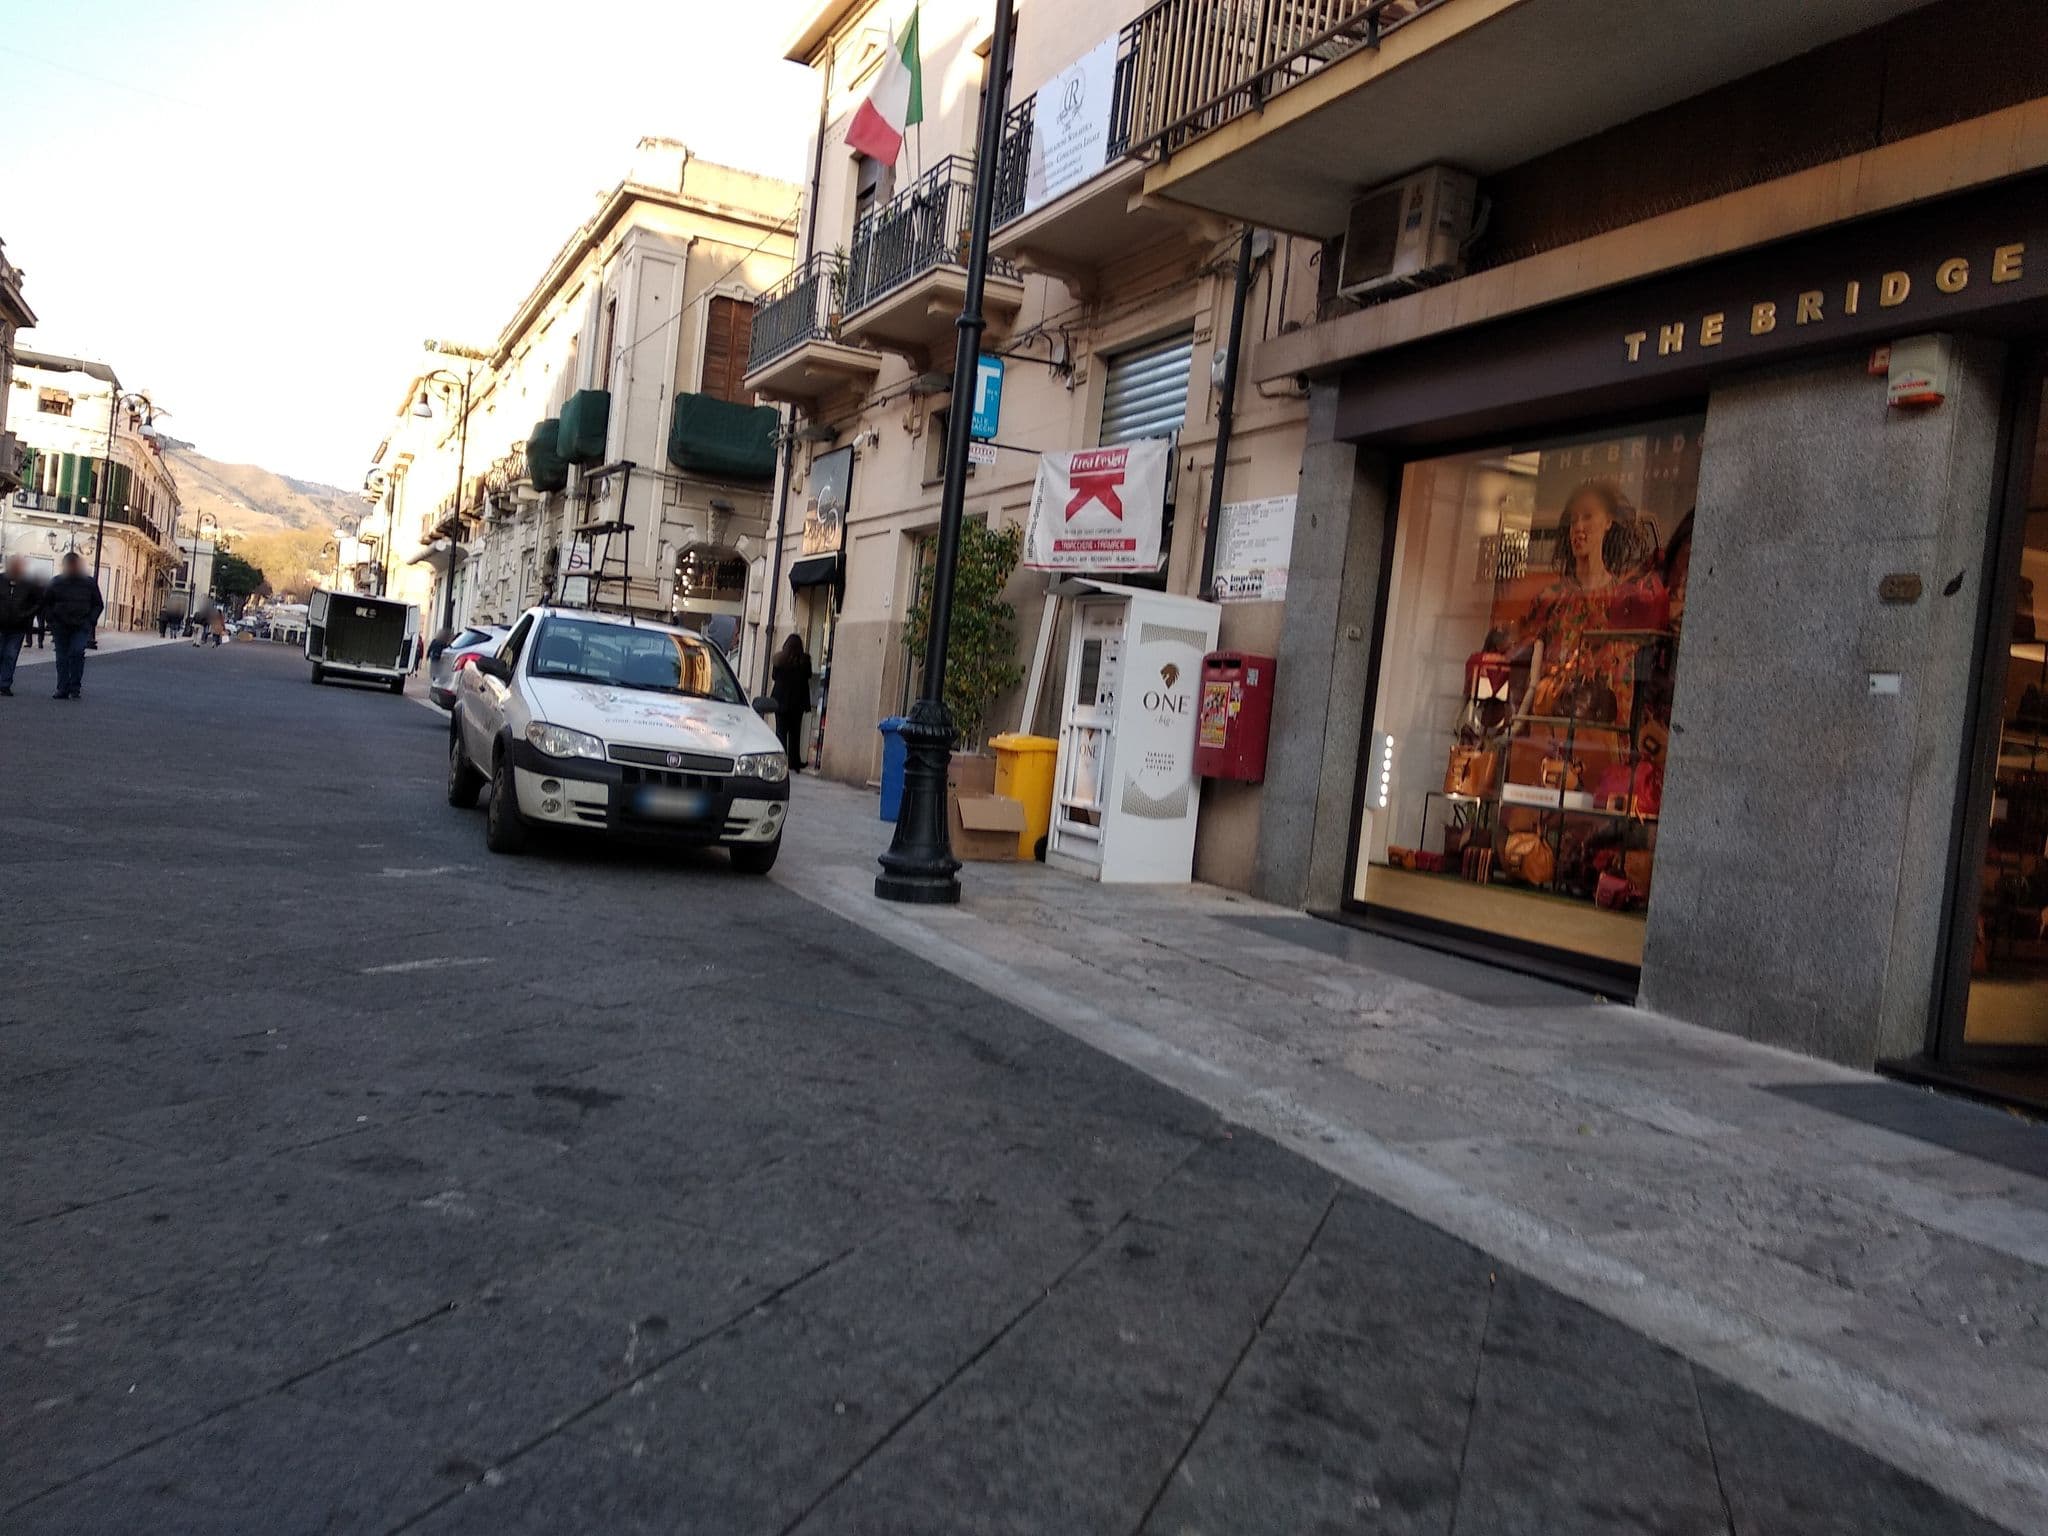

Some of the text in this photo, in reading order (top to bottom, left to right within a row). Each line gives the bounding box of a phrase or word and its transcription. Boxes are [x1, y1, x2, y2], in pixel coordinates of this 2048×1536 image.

[1624, 242, 2026, 363] THE BRIDGE
[975, 365, 1000, 414] T
[1143, 691, 1190, 715] ONE
